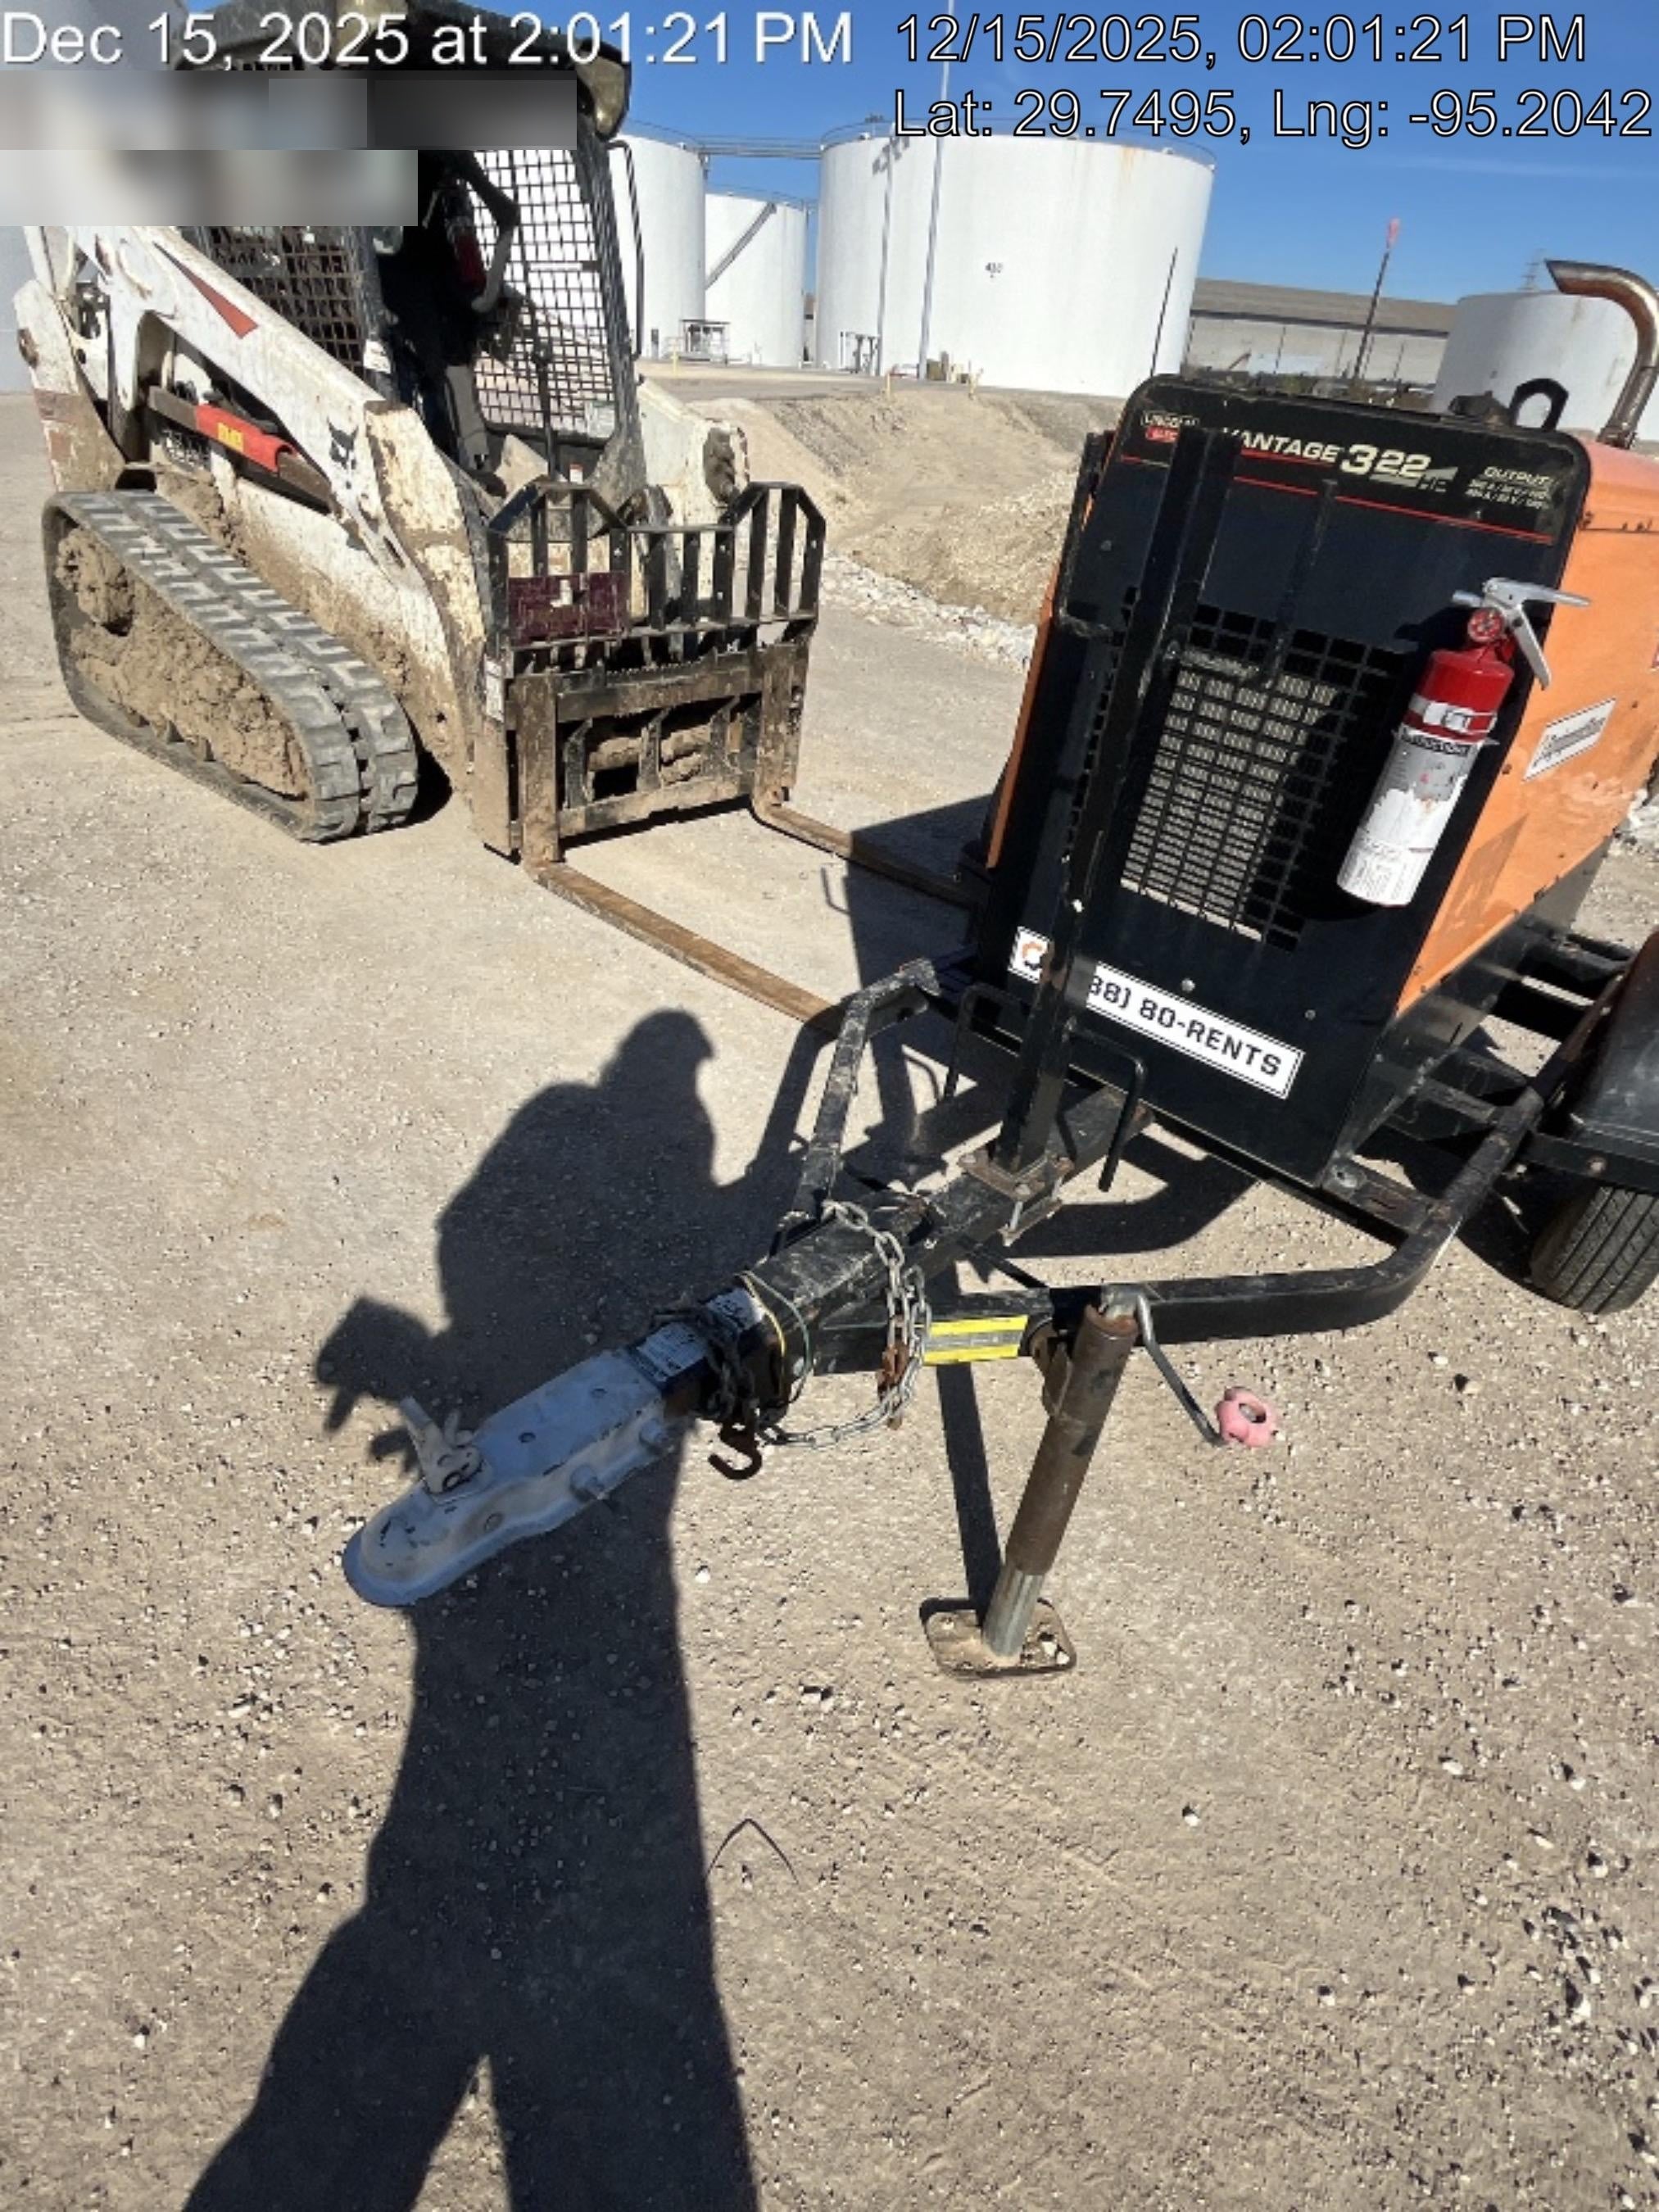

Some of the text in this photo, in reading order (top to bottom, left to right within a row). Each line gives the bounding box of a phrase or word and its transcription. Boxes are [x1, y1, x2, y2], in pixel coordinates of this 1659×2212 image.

[1231, 428, 1343, 464] ANTAGE
[1339, 443, 1431, 479] 322
[1139, 997, 1283, 1078] 80-RENTS
